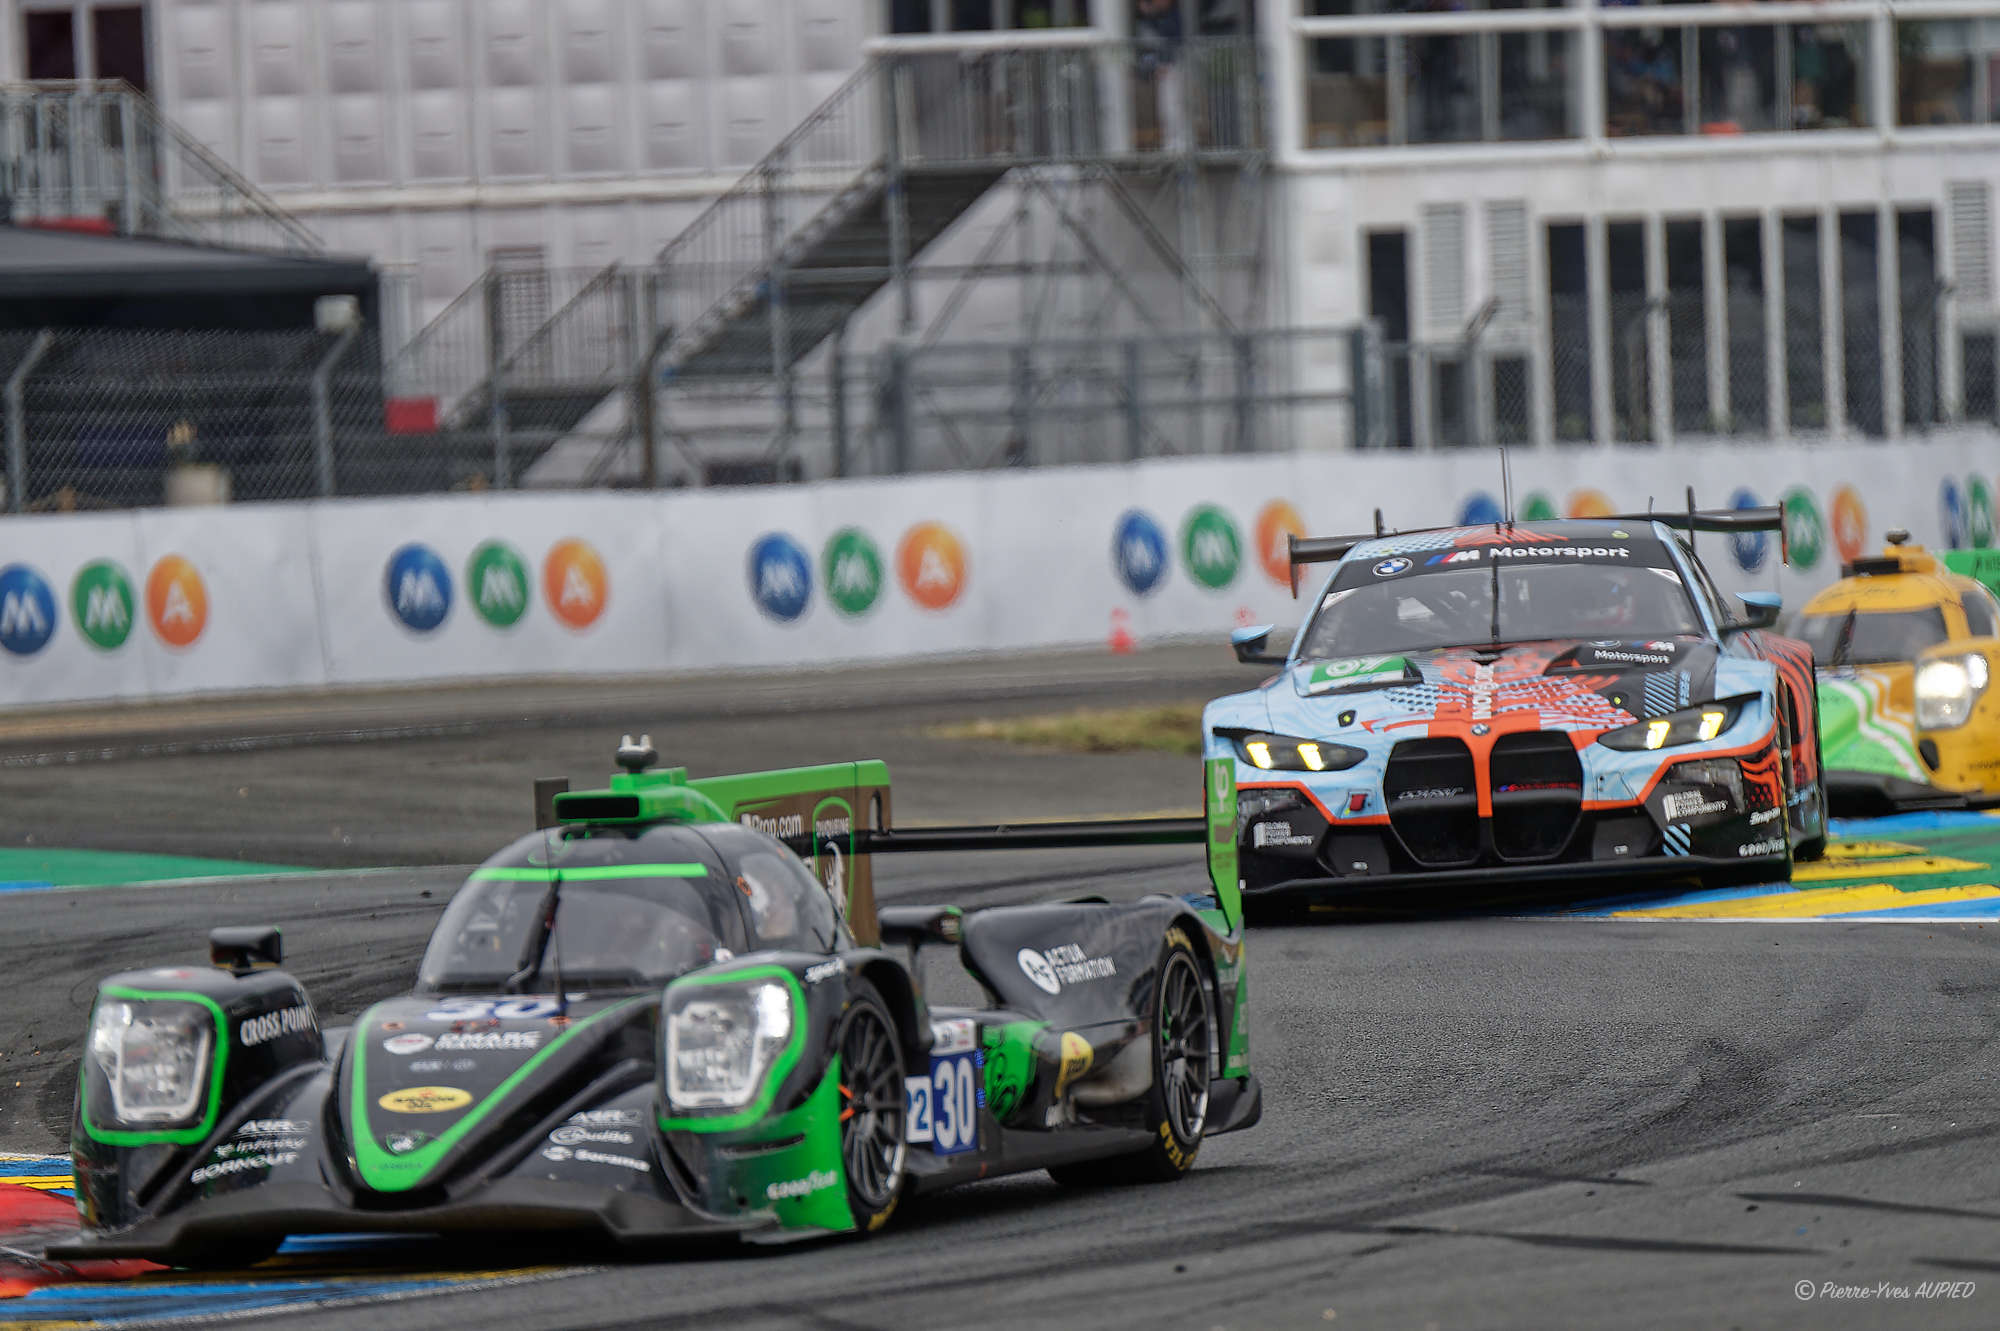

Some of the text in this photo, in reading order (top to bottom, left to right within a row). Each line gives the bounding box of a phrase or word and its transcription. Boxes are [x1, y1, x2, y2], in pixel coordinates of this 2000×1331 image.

[1489, 546, 1631, 559] Motorsport
[1594, 649, 1670, 664] Motorsport
[240, 1010, 282, 1047] CROSS
[935, 1056, 976, 1149] 30
